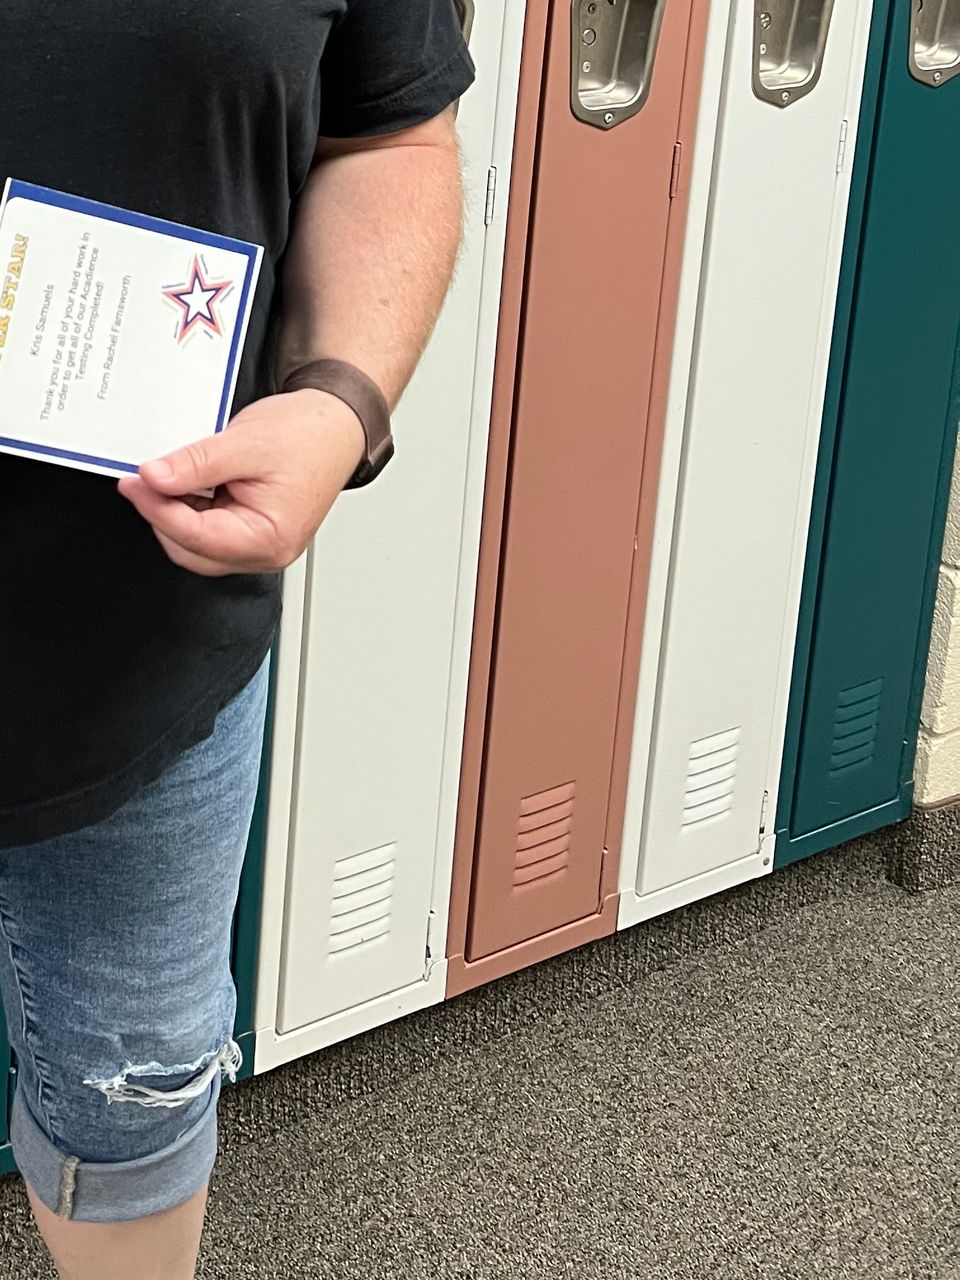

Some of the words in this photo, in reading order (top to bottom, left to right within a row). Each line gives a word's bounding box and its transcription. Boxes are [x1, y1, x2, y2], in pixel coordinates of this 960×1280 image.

[80, 231, 91, 242] in
[76, 244, 88, 269] work
[0, 233, 30, 311] STAR!
[68, 270, 81, 295] hard
[80, 247, 100, 301] Acadience
[35, 284, 55, 333] Samuels
[64, 296, 75, 320] your
[76, 302, 86, 321] our
[60, 320, 70, 333] of
[73, 321, 82, 334] of
[75, 342, 93, 381] Testing
[84, 280, 105, 341] Completed!
[57, 333, 67, 348] all
[70, 335, 80, 349] all
[103, 333, 118, 370] Rachel
[52, 348, 63, 365] for
[66, 350, 77, 368] get
[49, 366, 60, 387] you
[63, 369, 73, 381] to
[97, 371, 111, 400] From
[40, 387, 56, 421] Thank
[57, 382, 69, 412] order
